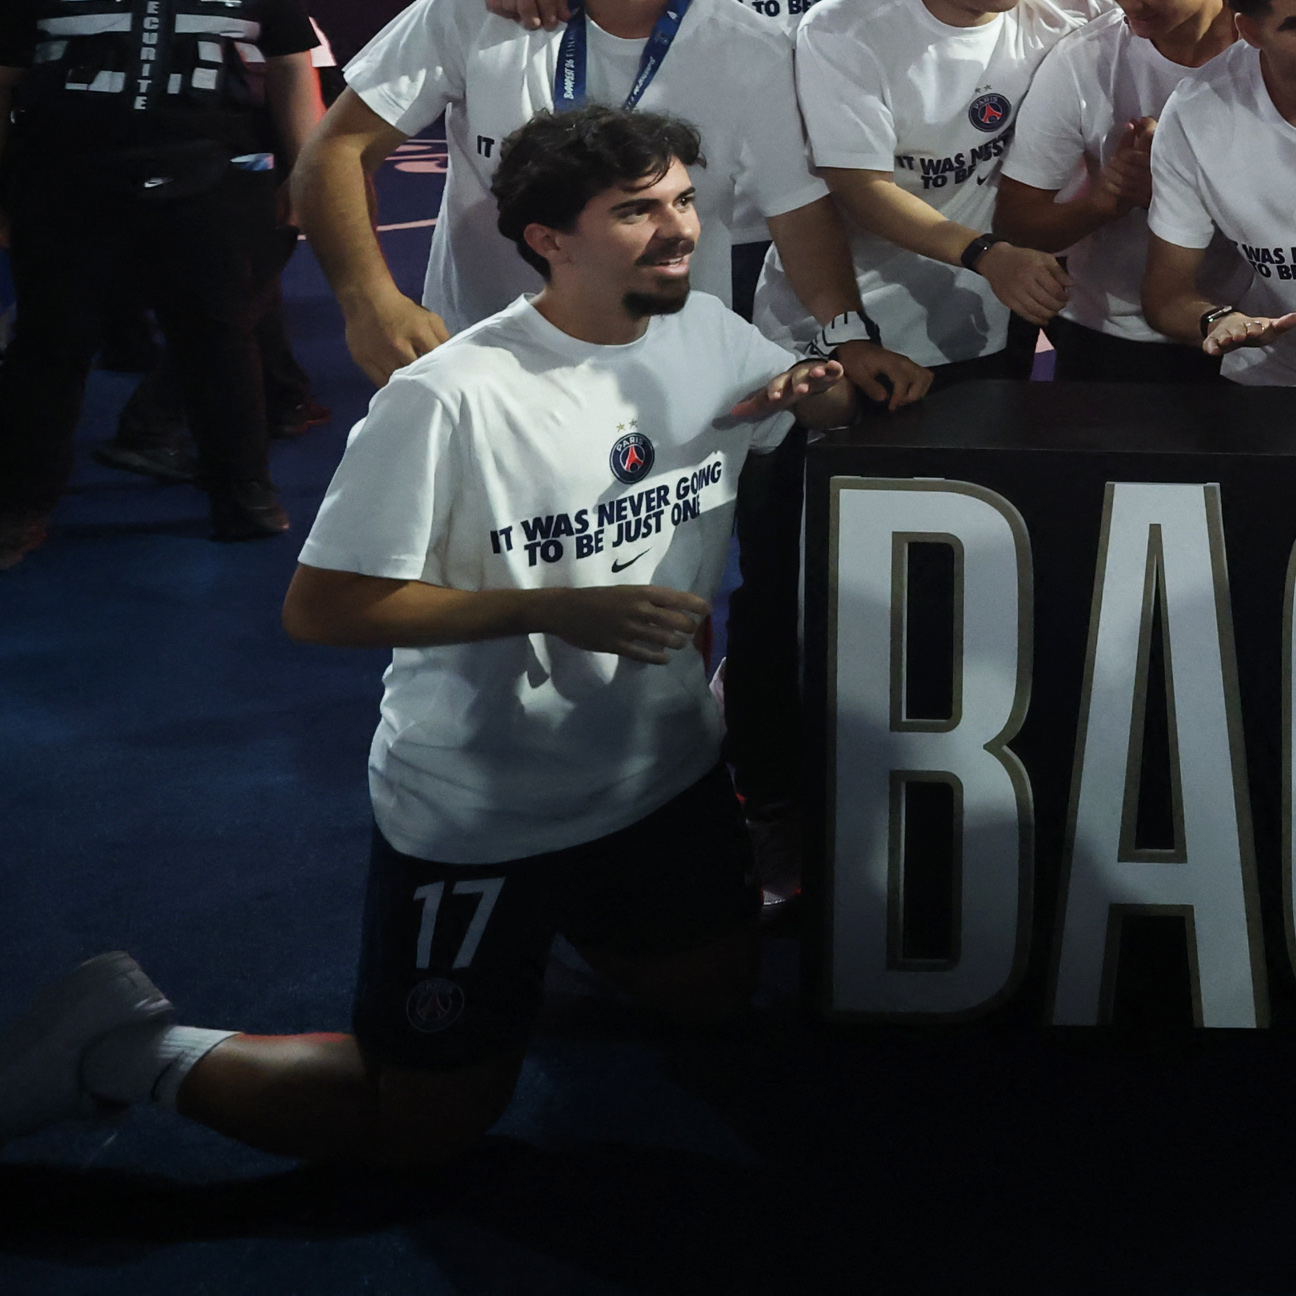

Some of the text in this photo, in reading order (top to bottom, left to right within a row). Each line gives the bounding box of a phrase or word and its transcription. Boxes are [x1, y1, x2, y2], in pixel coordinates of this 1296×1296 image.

[752, 0, 781, 18] TO
[477, 135, 496, 158] IT
[896, 152, 966, 176] IT WAS
[921, 174, 948, 190] TO
[616, 435, 644, 453] PARIS
[490, 461, 722, 554] IT WAS NEVER GOING
[524, 539, 564, 567] TO
[575, 528, 605, 559] BE
[612, 510, 665, 548] JUST
[413, 876, 507, 970] 17
